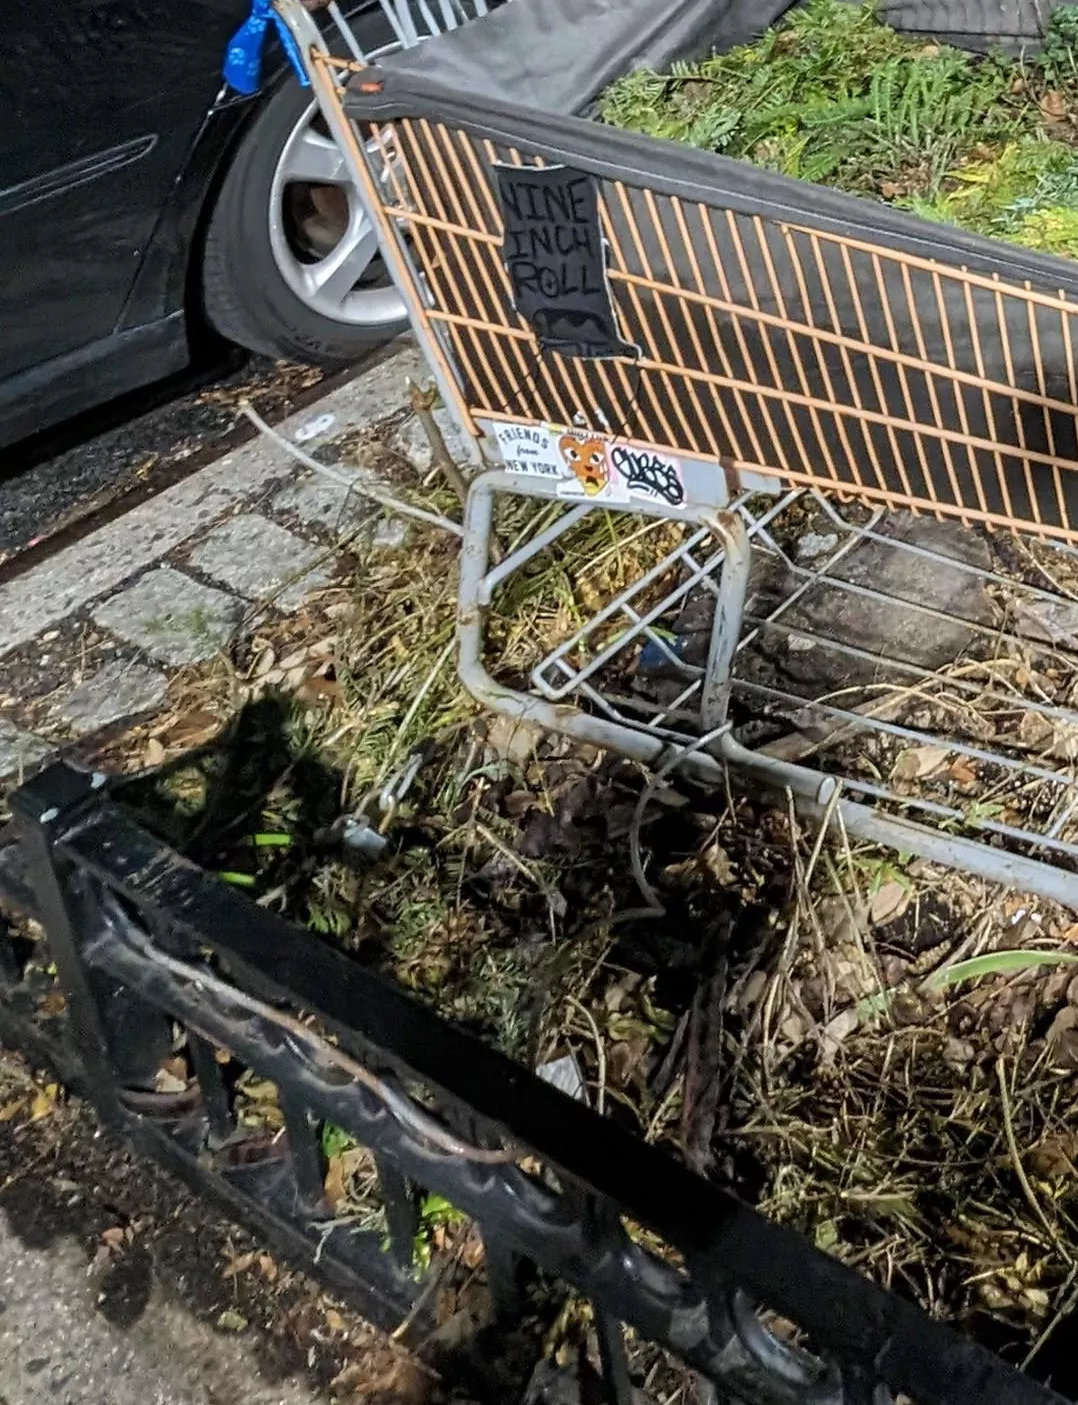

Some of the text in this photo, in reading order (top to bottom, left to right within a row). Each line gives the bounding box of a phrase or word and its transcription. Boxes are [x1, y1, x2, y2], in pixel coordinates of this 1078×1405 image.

[500, 176, 590, 225] NINE
[506, 225, 594, 260] INCH
[510, 261, 601, 299] ROLL
[497, 427, 549, 450] FRIENDS
[516, 444, 540, 457] from
[505, 459, 560, 476] NEW YORK
